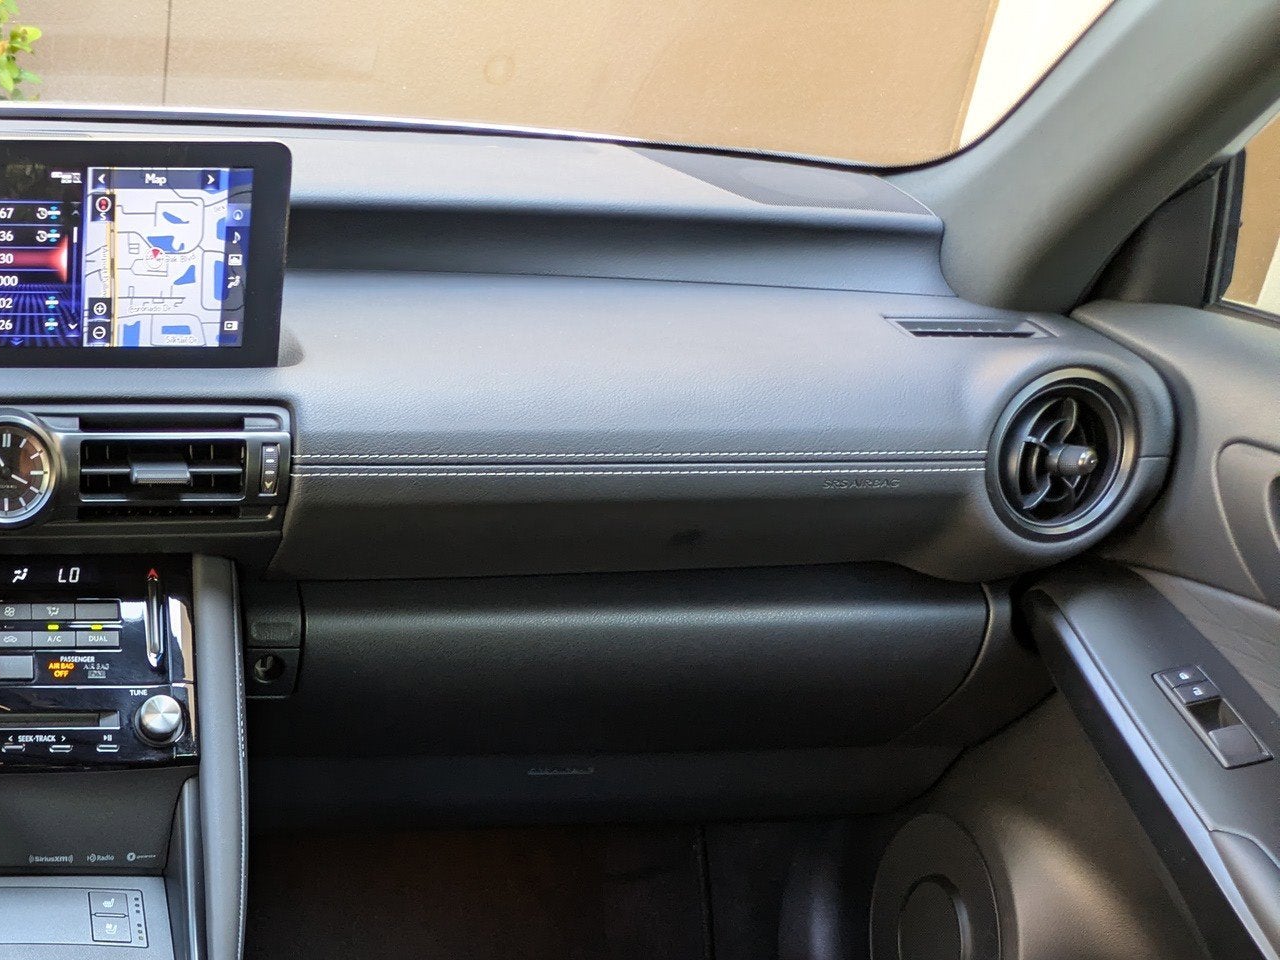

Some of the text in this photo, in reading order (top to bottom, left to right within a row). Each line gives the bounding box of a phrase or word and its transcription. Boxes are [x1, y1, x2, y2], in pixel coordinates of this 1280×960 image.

[145, 173, 167, 186] Map
[822, 478, 900, 489] SRS AIRBAG
[58, 567, 80, 584] LO
[47, 635, 62, 643] A/C
[88, 635, 108, 643] DUAL
[54, 670, 69, 678] OFF
